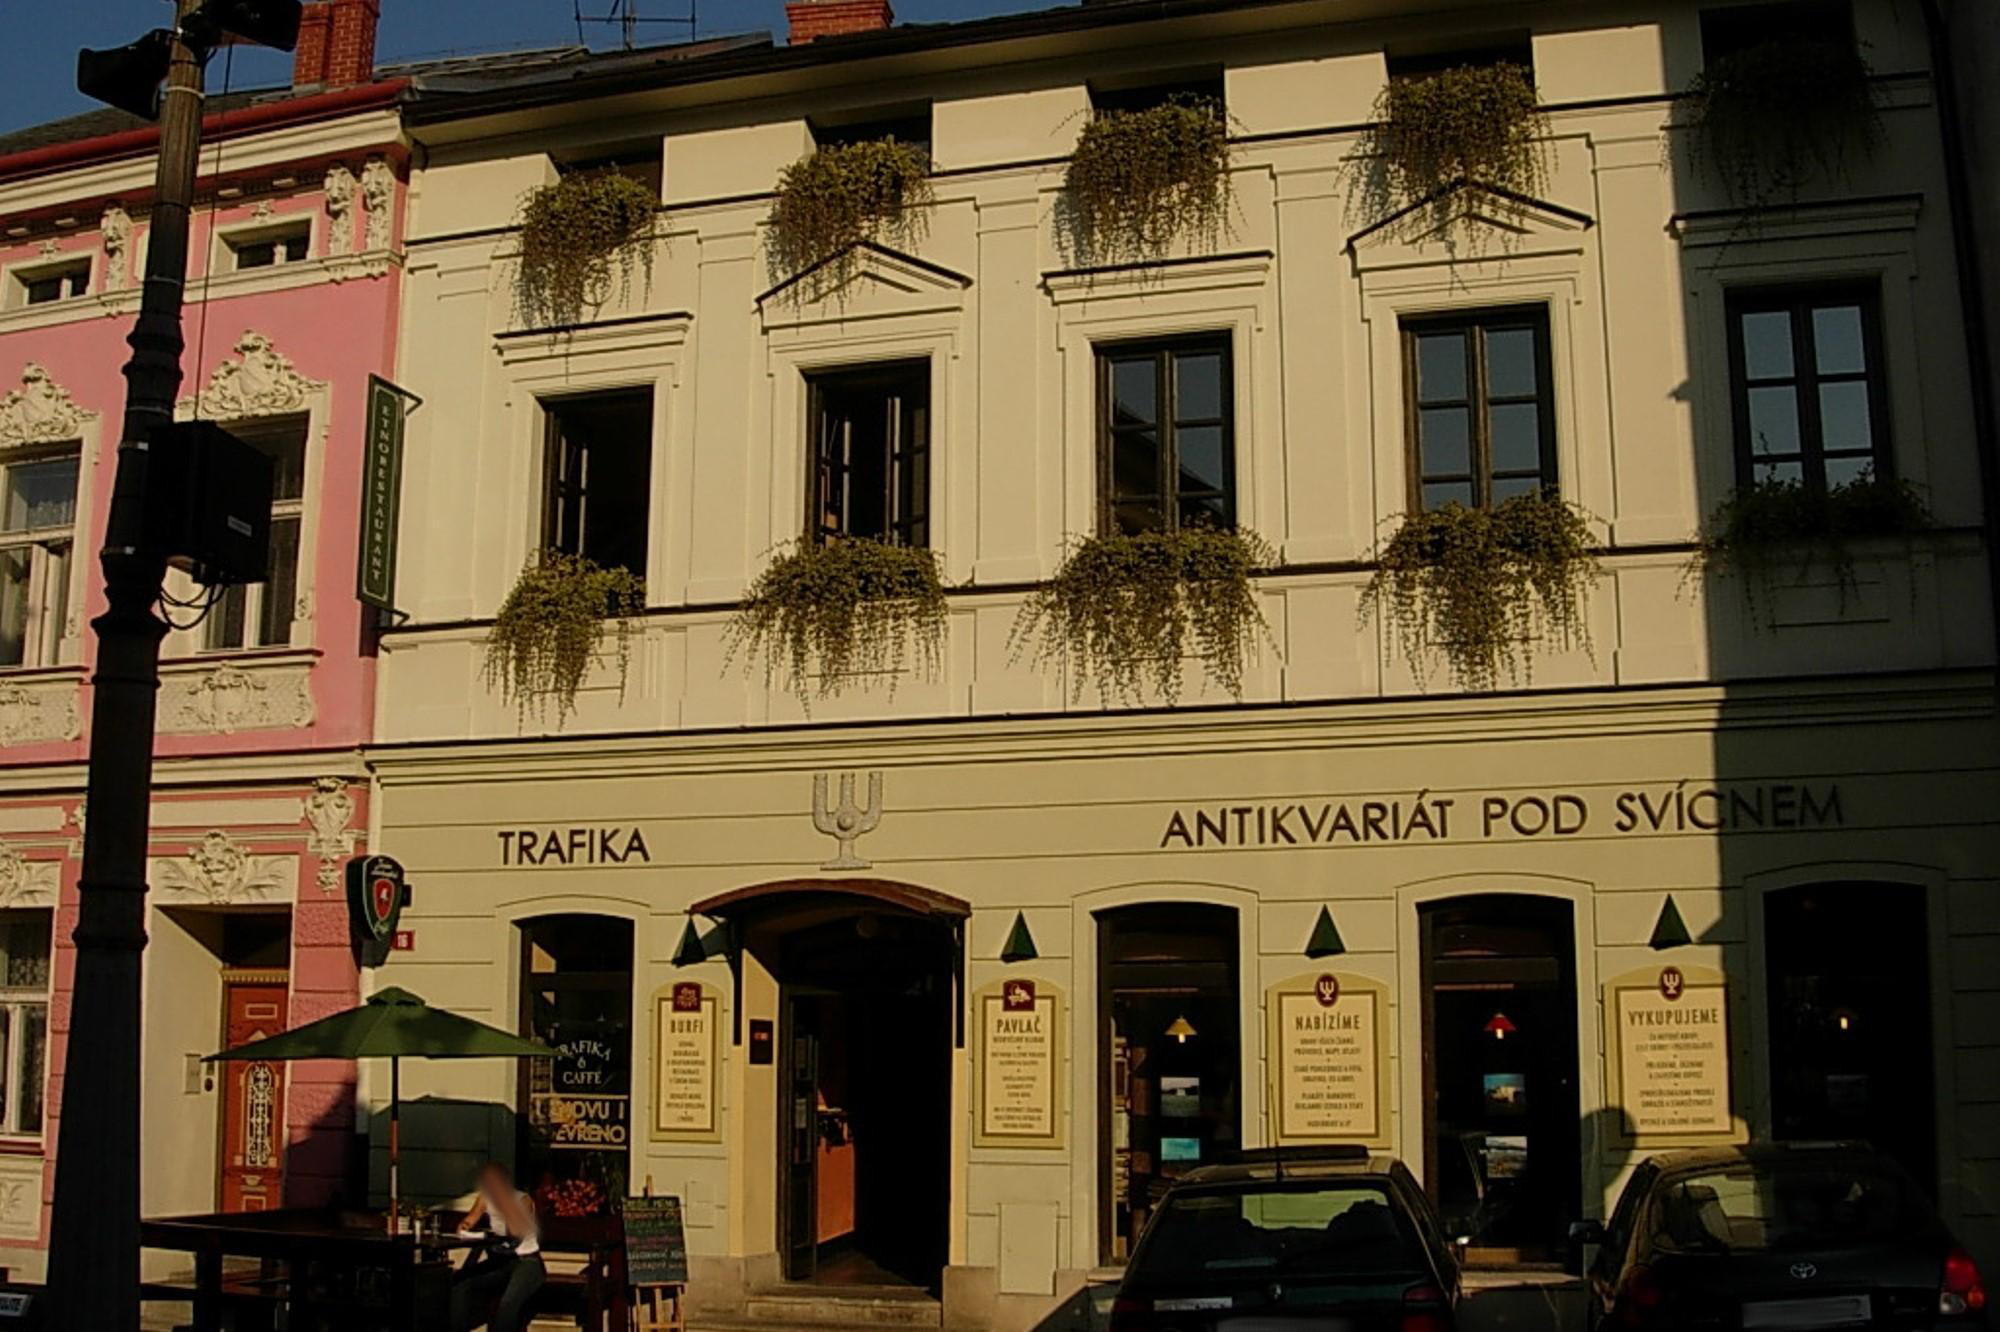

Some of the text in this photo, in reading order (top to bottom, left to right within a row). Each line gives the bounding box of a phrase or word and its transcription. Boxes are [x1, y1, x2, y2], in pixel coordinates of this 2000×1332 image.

[1160, 779, 1844, 848] ANTIKVARIÁT POD SVÍCNEM
[498, 826, 651, 866] TRAFIKA
[996, 1014, 1042, 1033] PAVLAČ
[1295, 1011, 1361, 1031] NABÍZÍME
[1628, 1009, 1719, 1026] VYKUPUJEME
